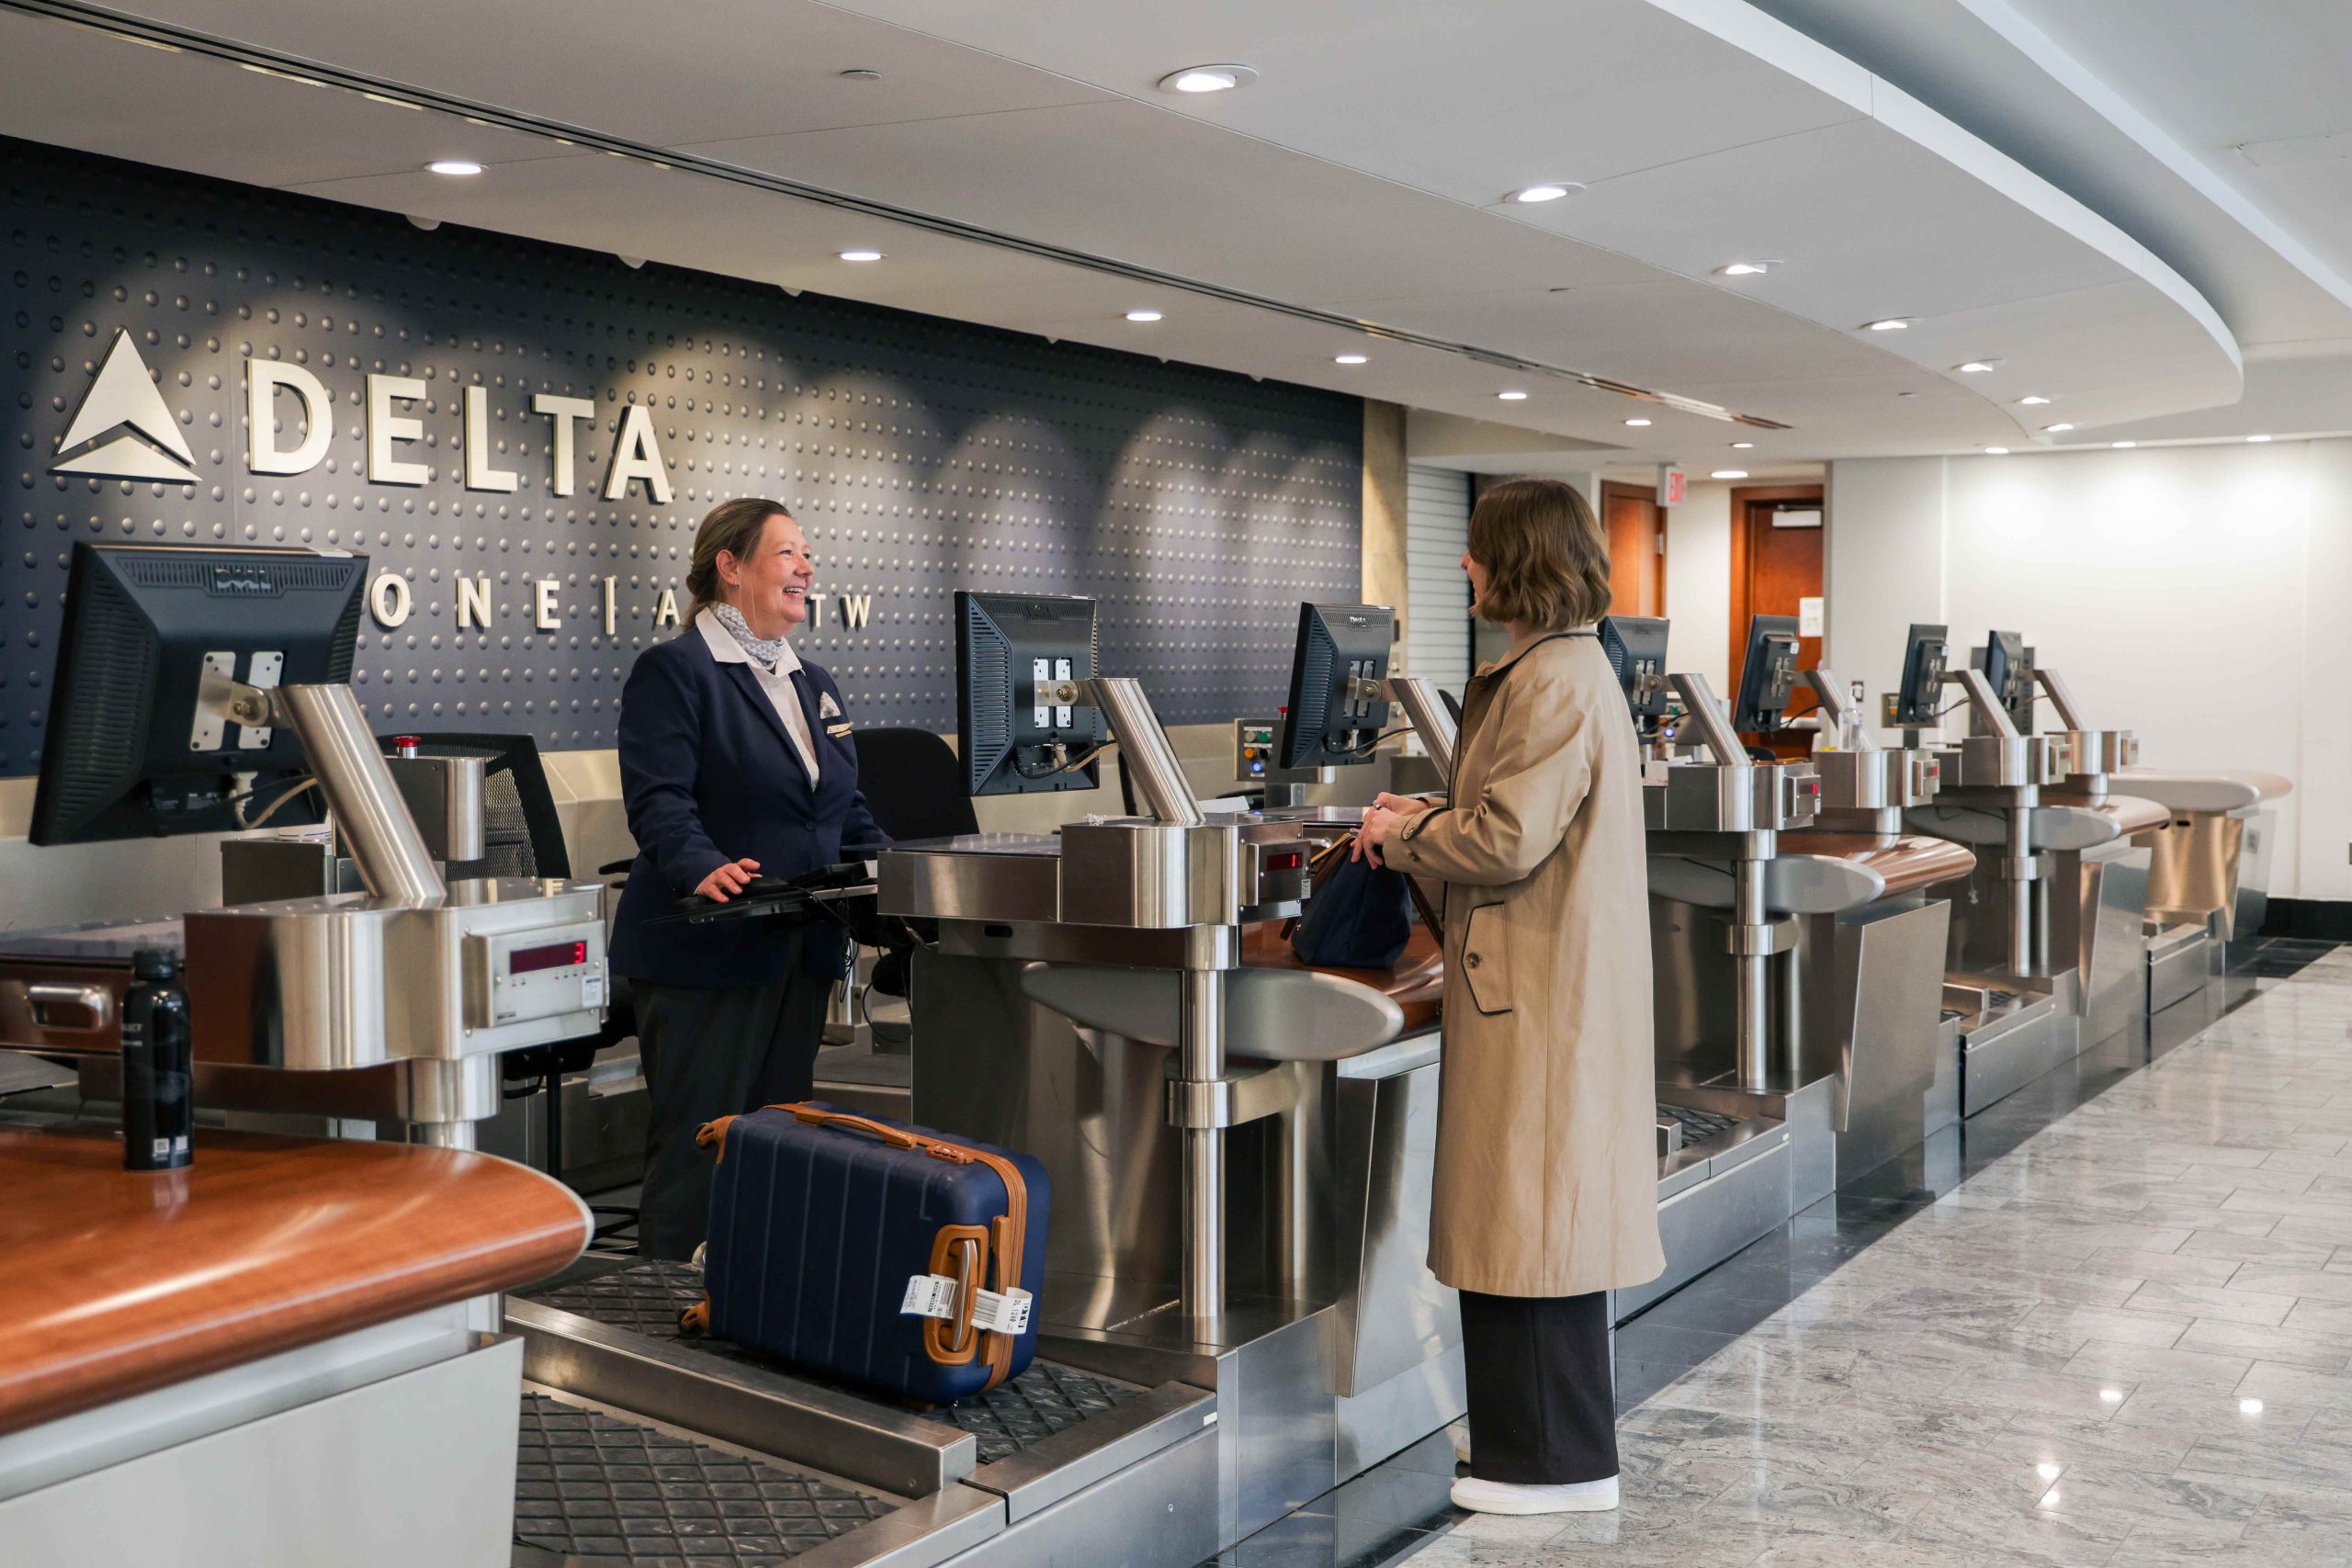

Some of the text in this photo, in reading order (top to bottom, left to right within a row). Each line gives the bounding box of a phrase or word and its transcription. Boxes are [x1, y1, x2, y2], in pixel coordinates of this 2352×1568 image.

[246, 358, 673, 503] DELTA
[370, 573, 561, 629] ONE
[572, 941, 586, 965] 3
